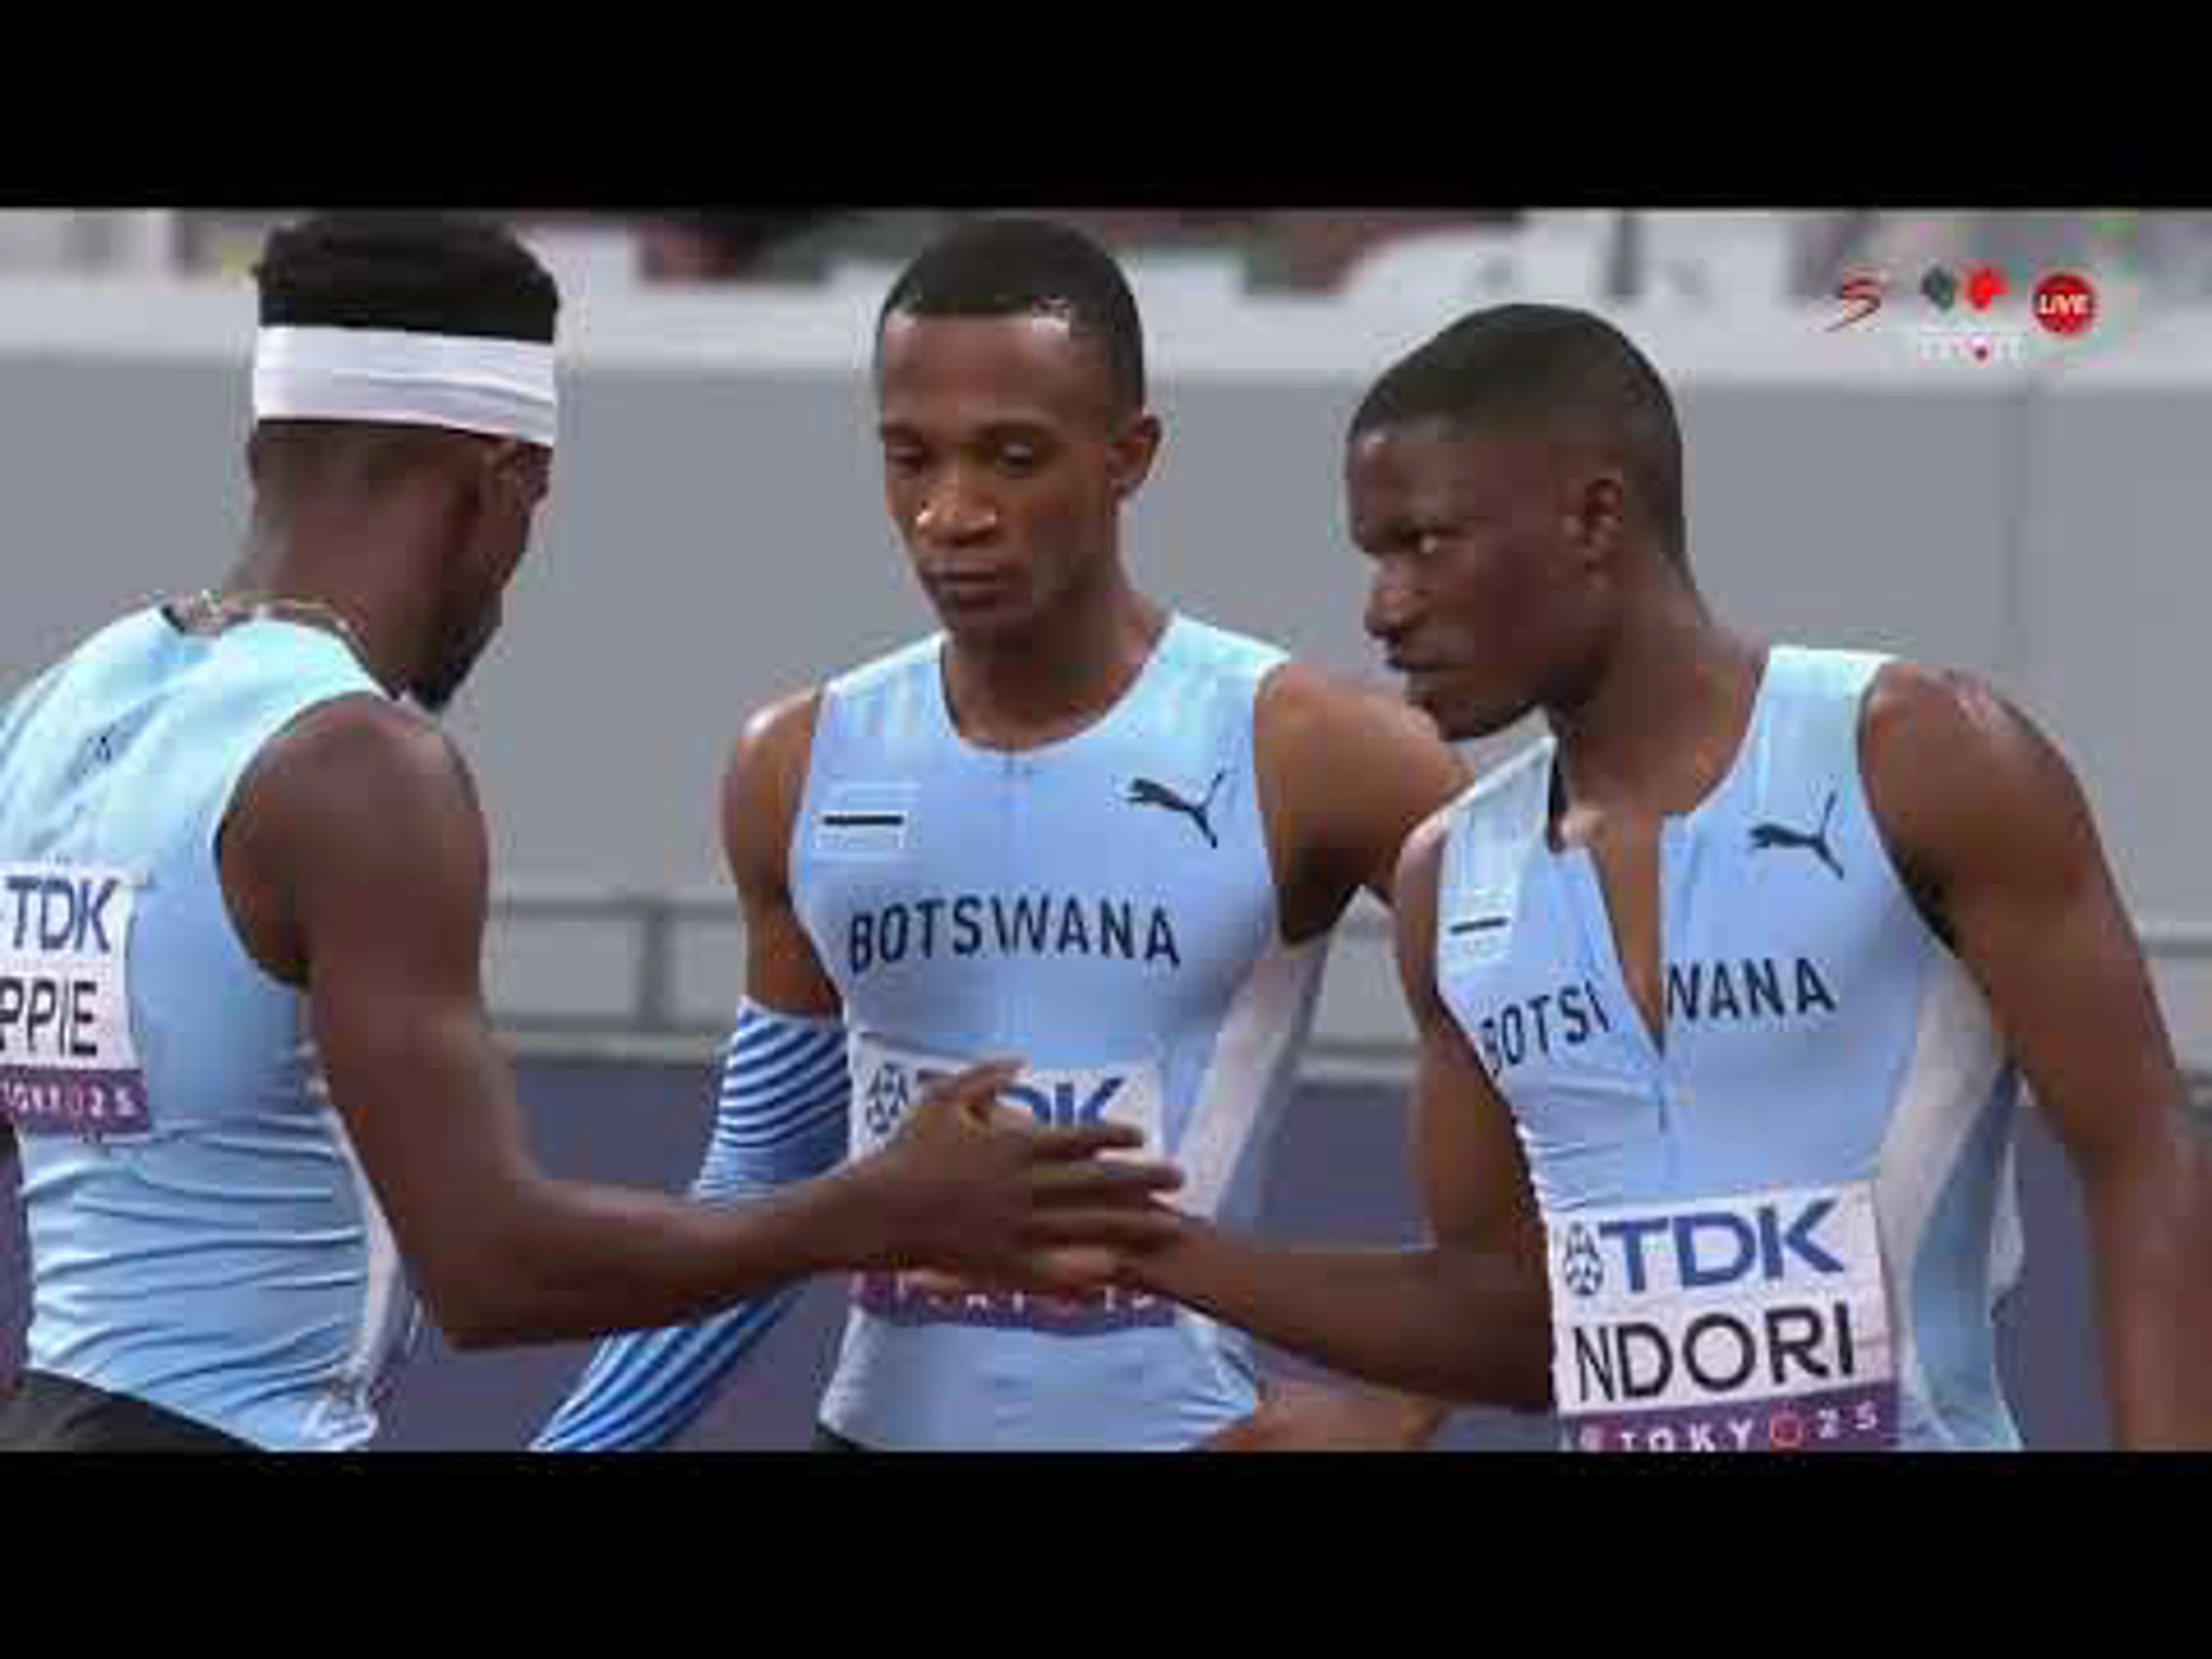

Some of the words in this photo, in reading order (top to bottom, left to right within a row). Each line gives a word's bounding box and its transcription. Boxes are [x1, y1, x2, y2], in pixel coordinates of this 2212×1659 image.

[5, 876, 119, 954] TDK
[848, 895, 1181, 975] BOTSWANA
[0, 978, 97, 1056] PPIE
[1598, 1198, 1844, 1293] TDK
[1572, 1300, 1855, 1402] NDORI
